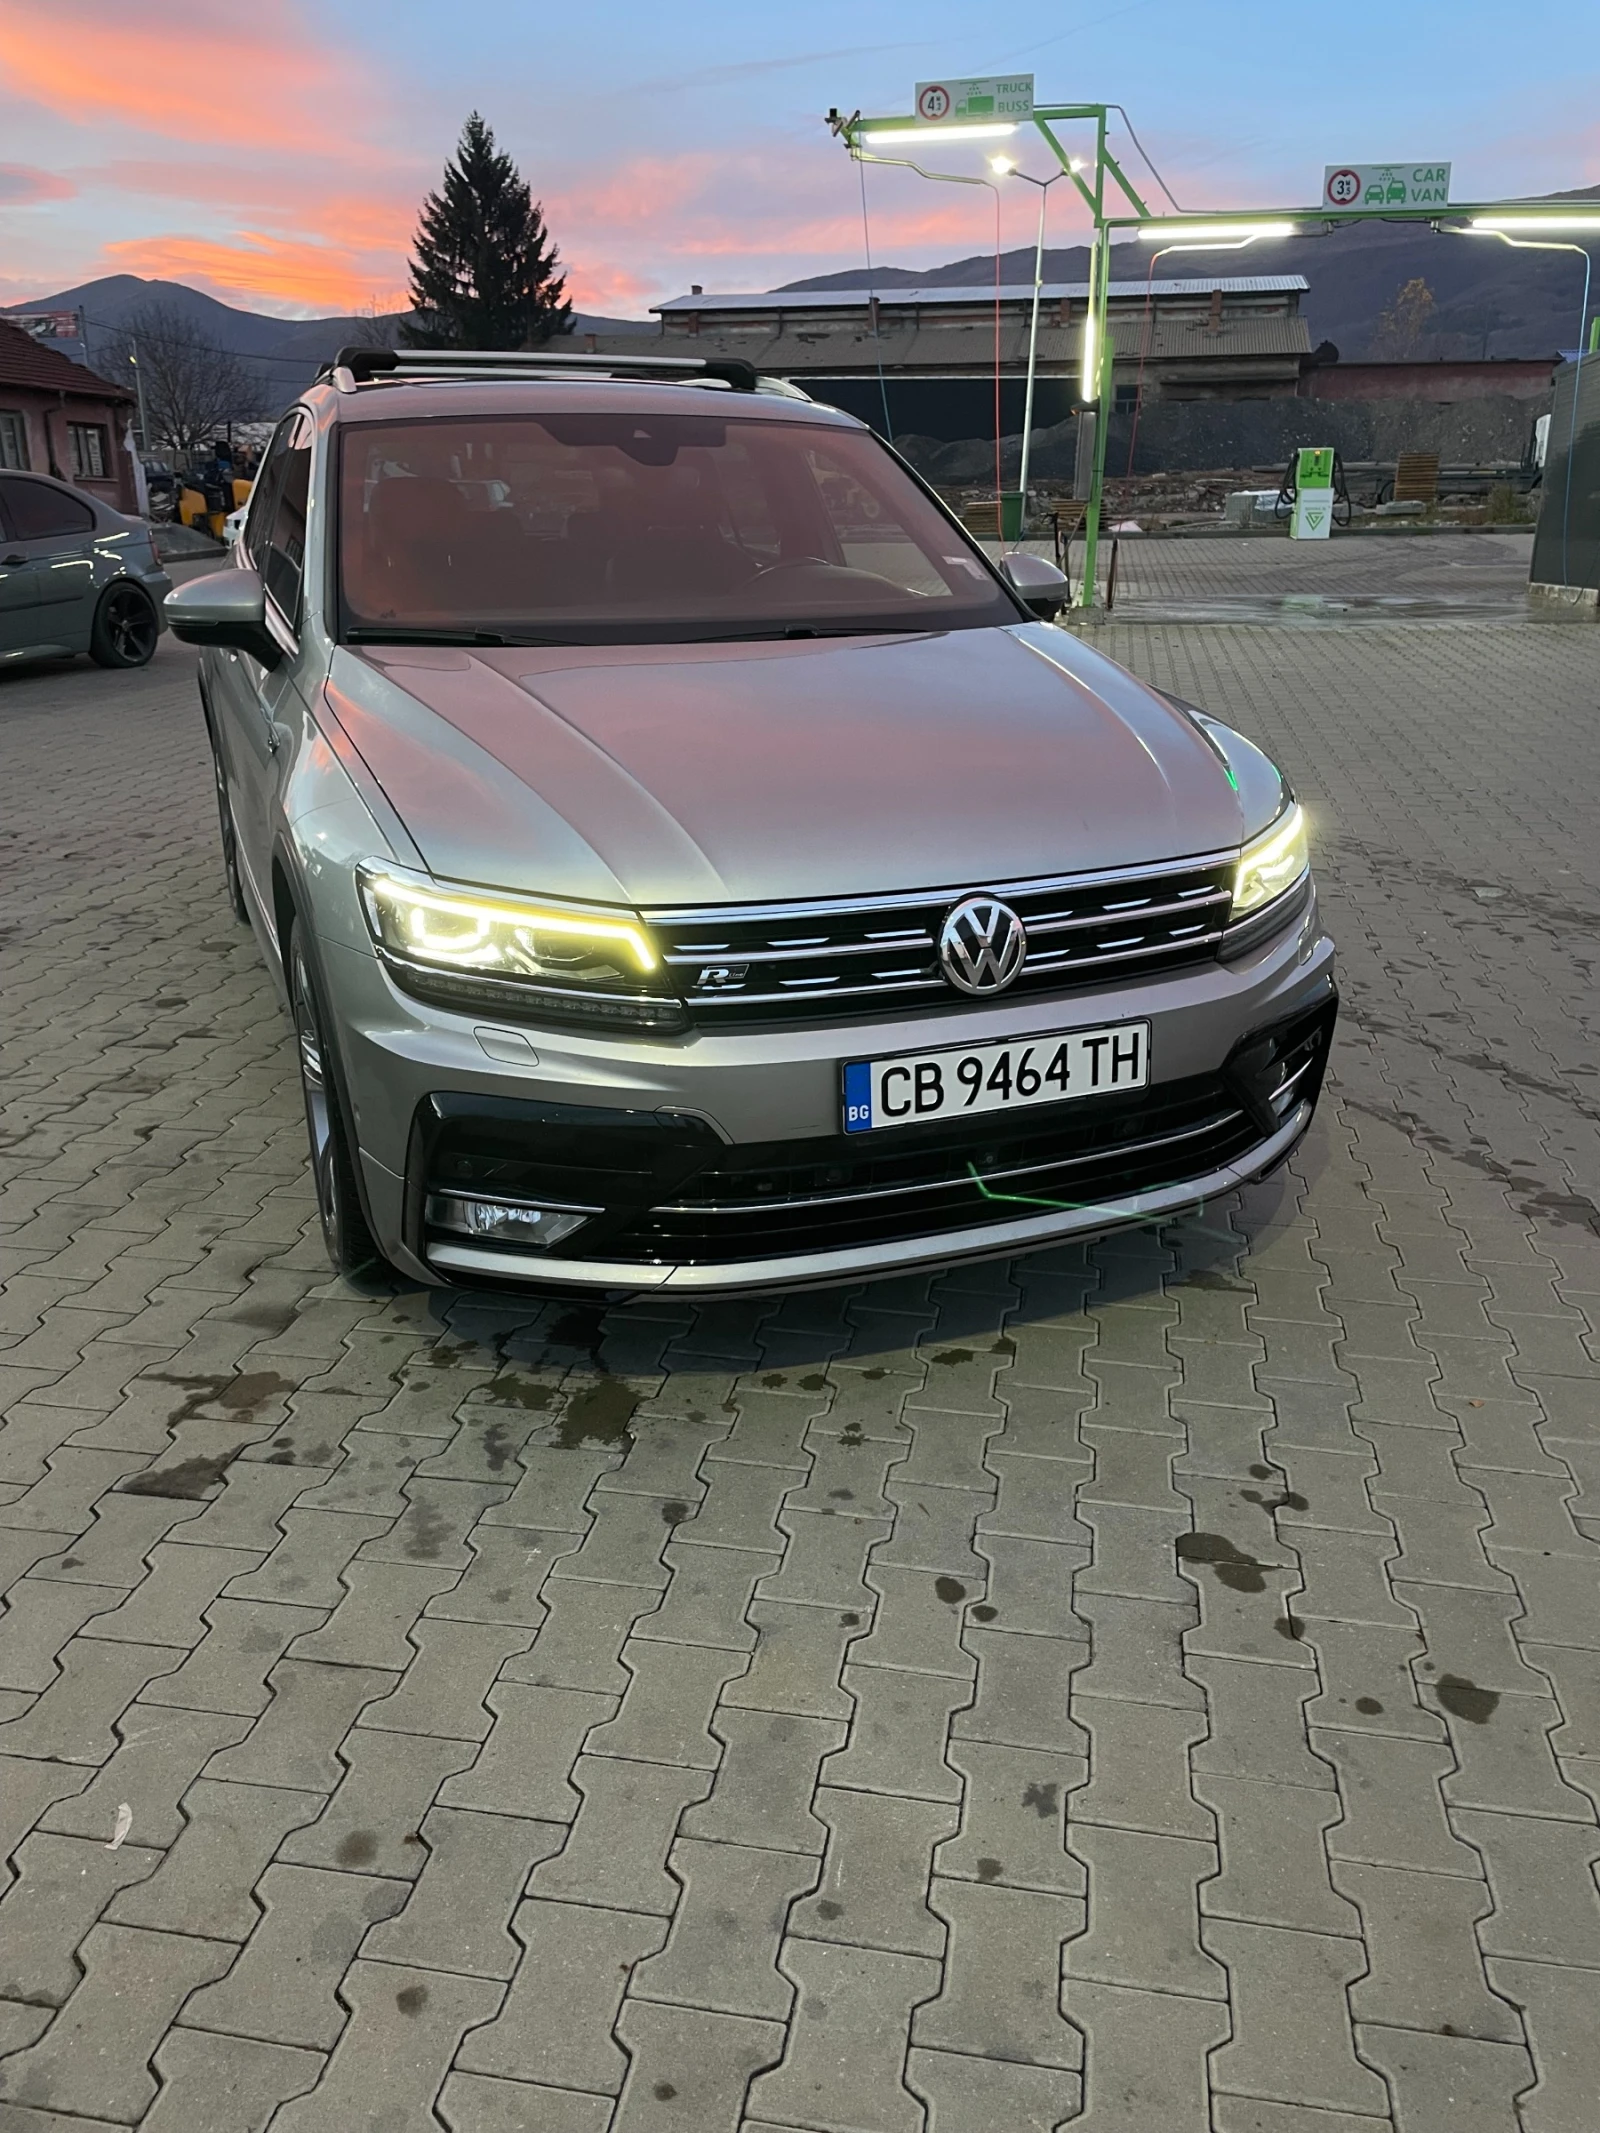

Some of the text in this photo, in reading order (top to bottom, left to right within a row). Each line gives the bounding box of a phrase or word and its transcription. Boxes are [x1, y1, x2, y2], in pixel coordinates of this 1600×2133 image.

[996, 82, 1032, 94] TRUCK
[998, 100, 1029, 113] BUSS
[1413, 168, 1446, 182] CAR
[1411, 188, 1447, 202] VAN
[881, 1032, 1140, 1117] CB 9464 TH
[848, 1105, 869, 1121] BG
